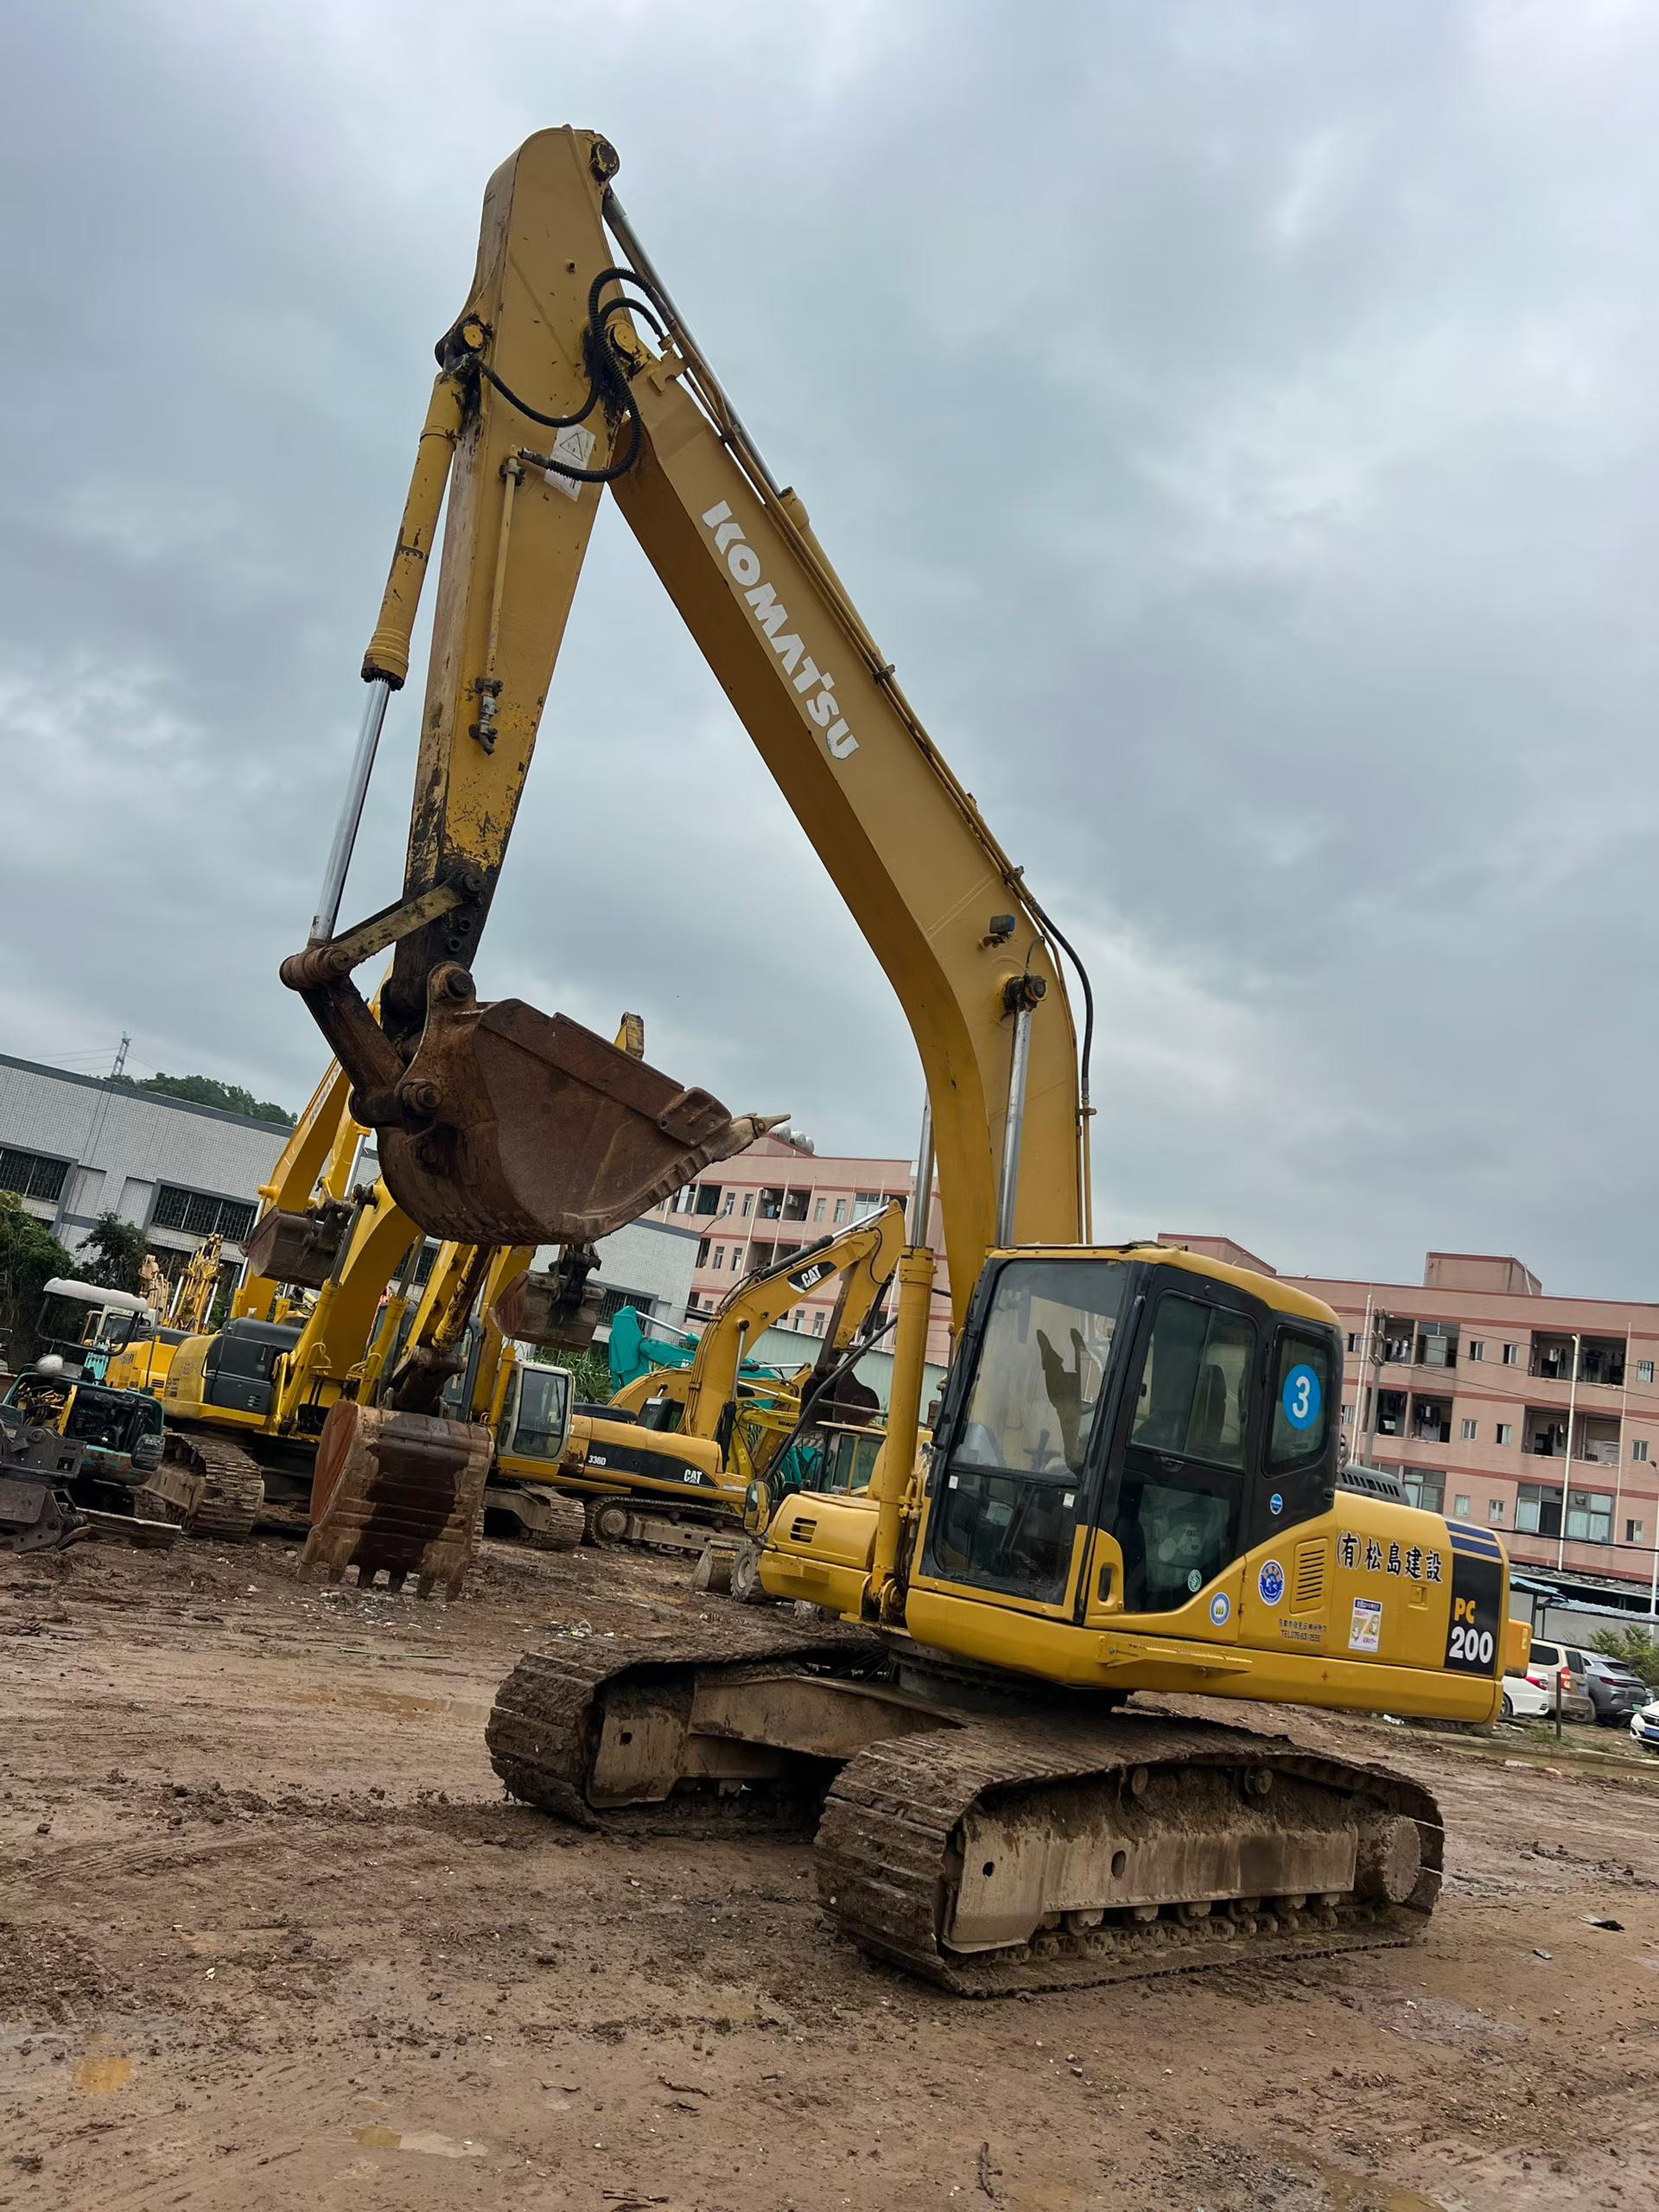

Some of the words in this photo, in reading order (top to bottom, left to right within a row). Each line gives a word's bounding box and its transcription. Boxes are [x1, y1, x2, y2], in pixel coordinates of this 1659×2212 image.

[702, 499, 860, 760] KOMATSU
[308, 1062, 342, 1125] KOMATS
[801, 1264, 822, 1287] CAT
[1292, 1376, 1310, 1419] 3
[588, 1454, 607, 1466] 336D
[683, 1469, 702, 1484] CAT
[1336, 1531, 1443, 1583] (有)松島建設
[1453, 1598, 1476, 1624] PC
[1448, 1625, 1494, 1664] 200
